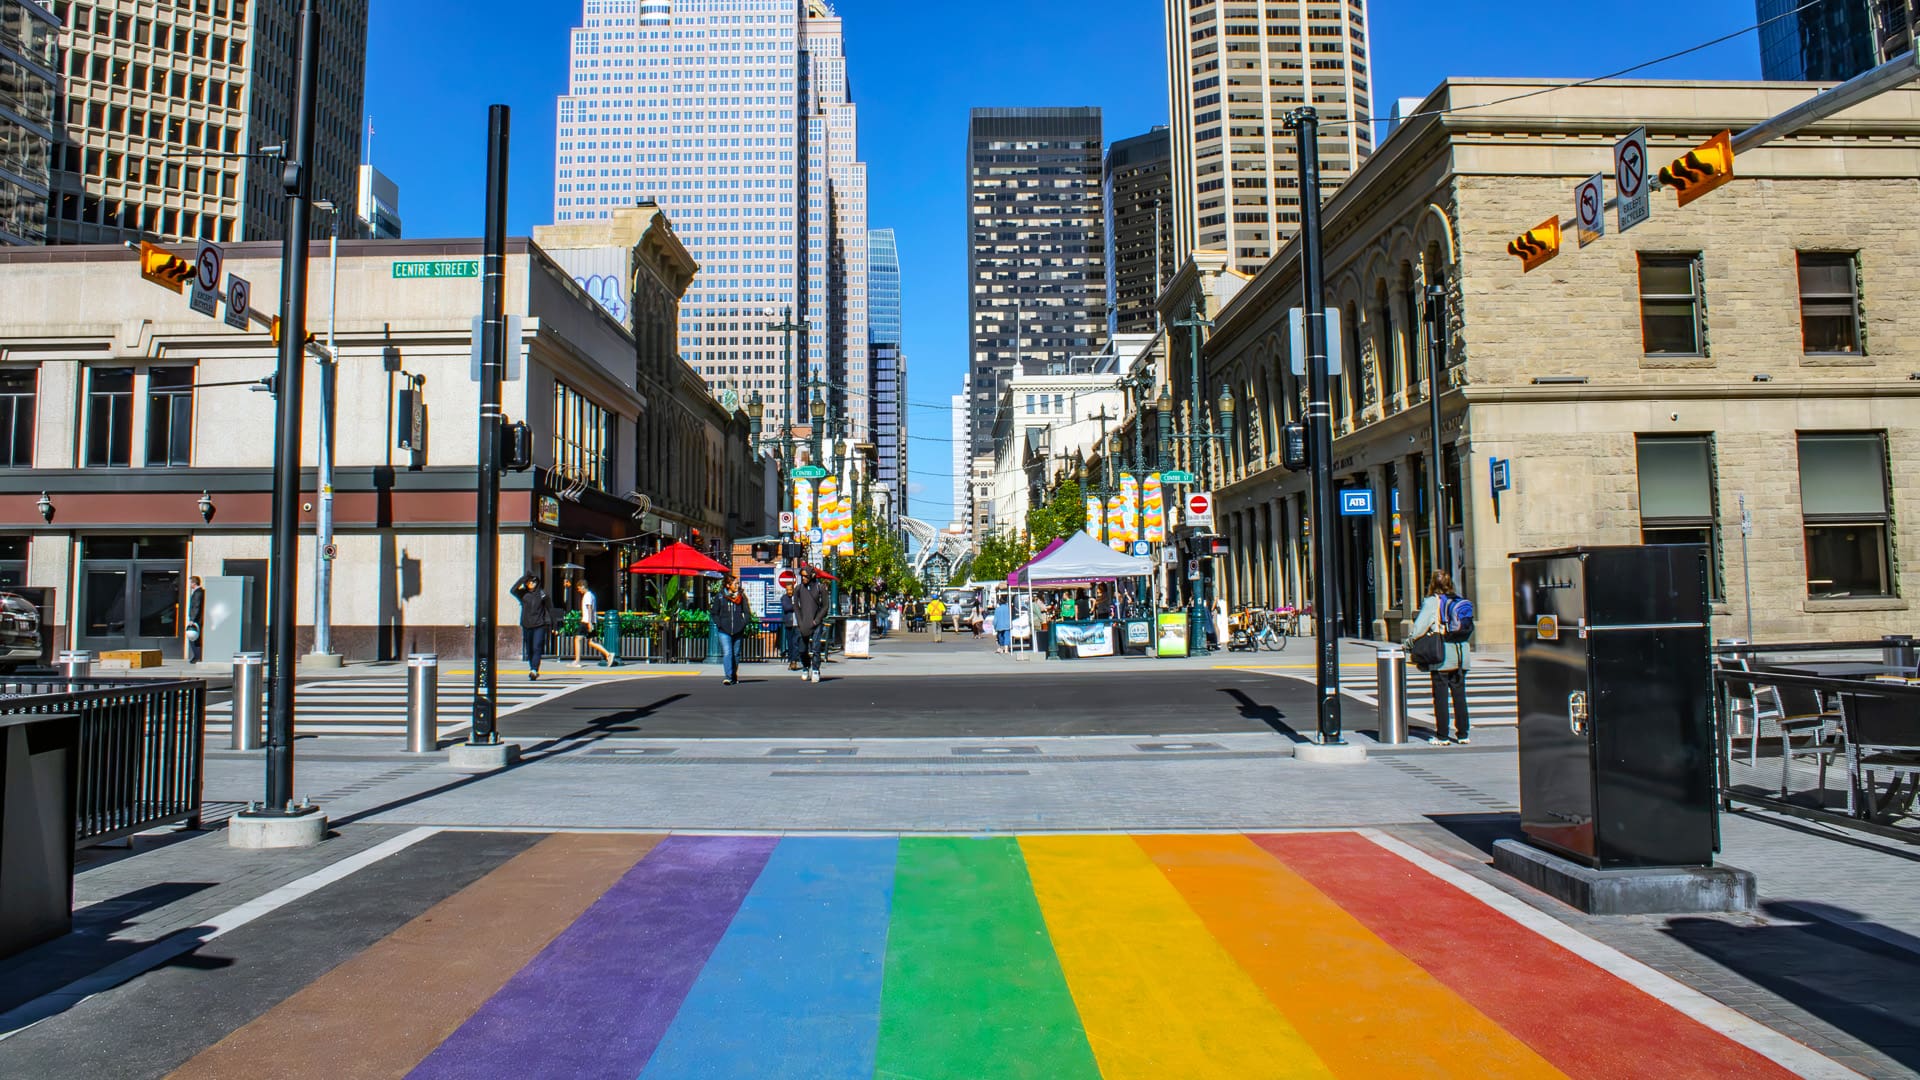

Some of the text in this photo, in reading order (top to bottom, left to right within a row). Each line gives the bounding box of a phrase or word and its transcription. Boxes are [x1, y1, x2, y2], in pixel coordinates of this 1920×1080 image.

[1623, 196, 1641, 213] EXCEPT
[1621, 206, 1645, 226] BICYCLES
[395, 262, 478, 277] CENTRE STREET S
[1349, 497, 1366, 507] ATB
